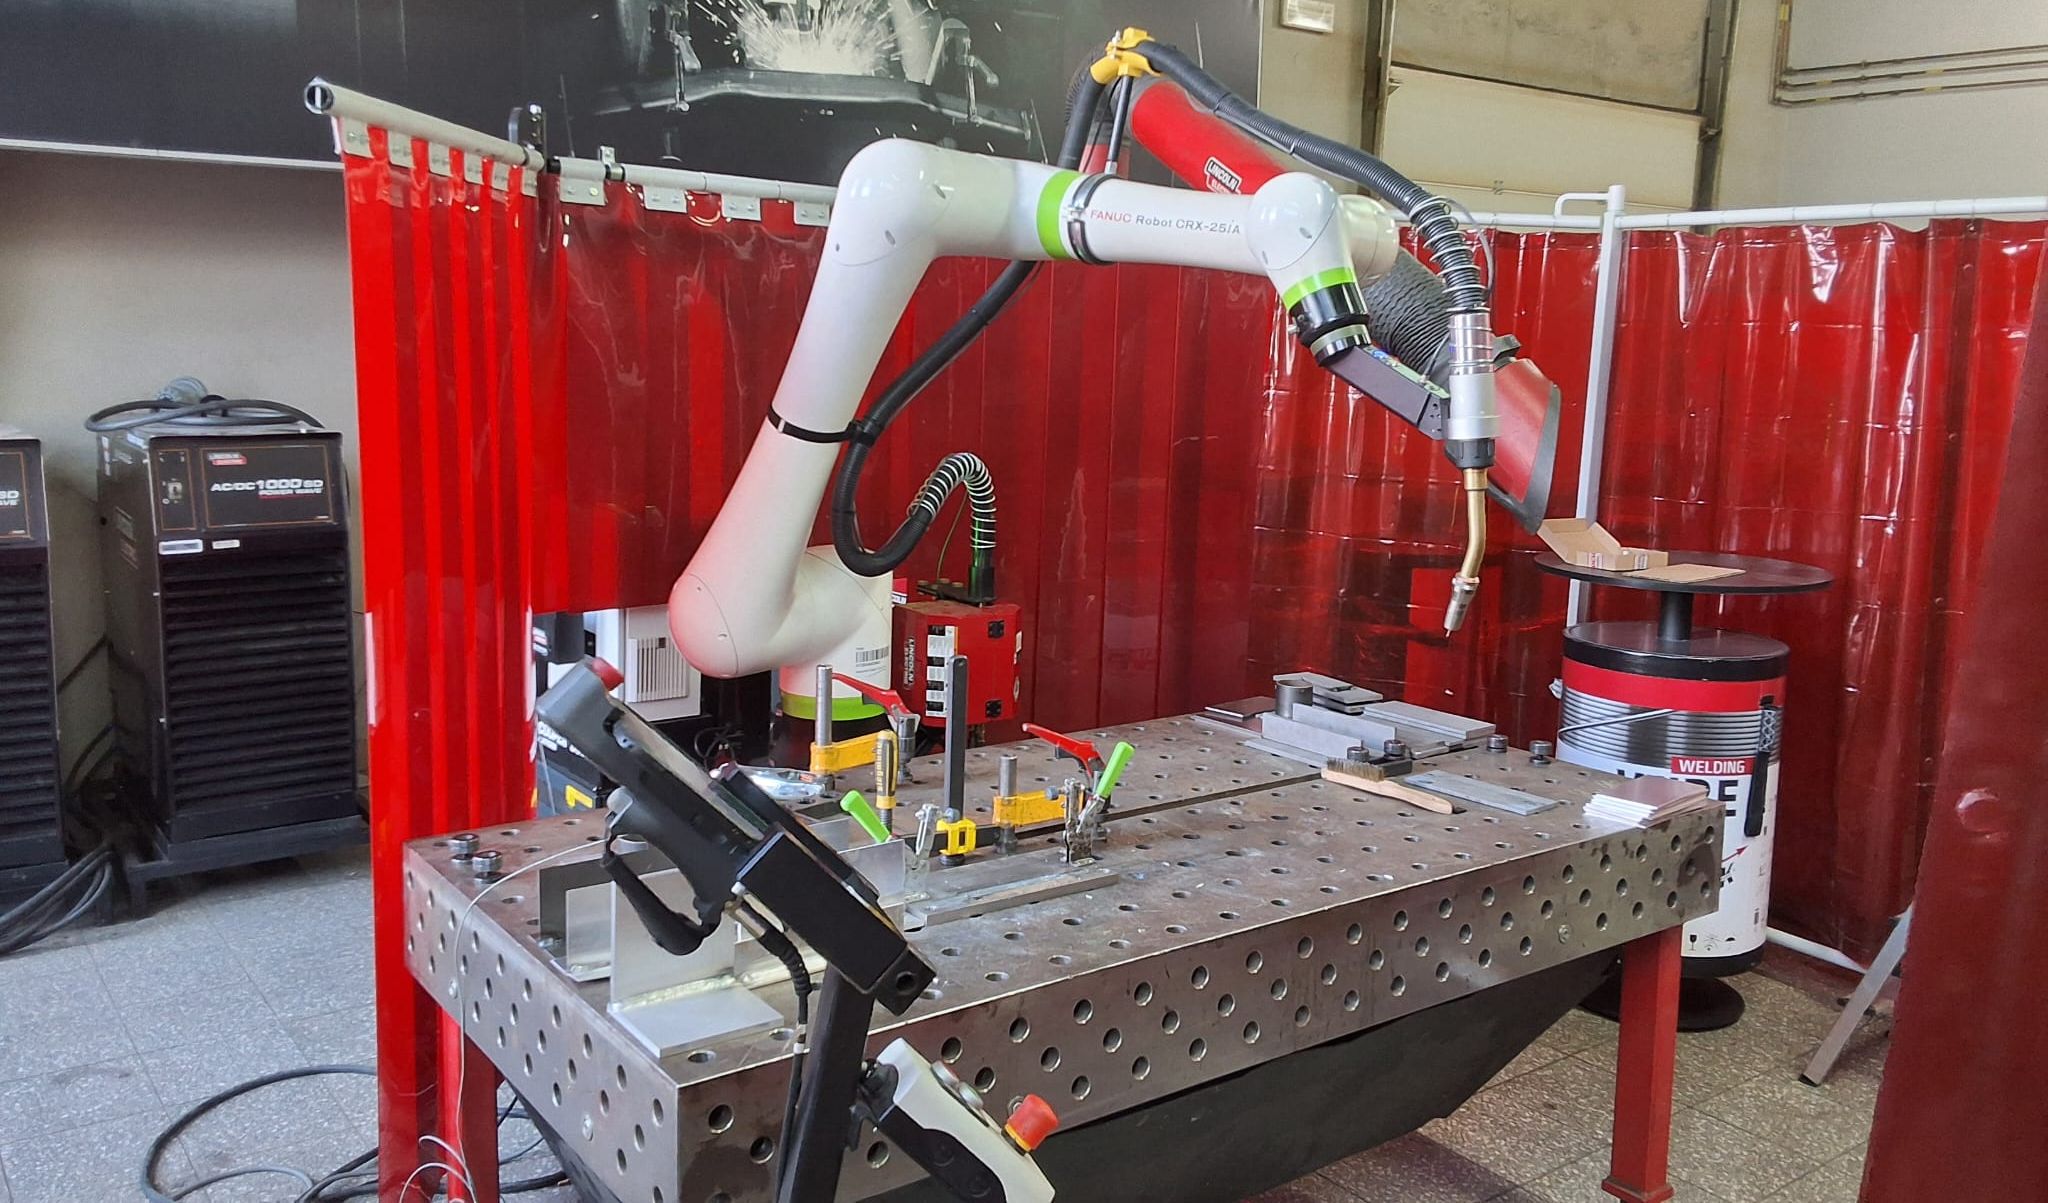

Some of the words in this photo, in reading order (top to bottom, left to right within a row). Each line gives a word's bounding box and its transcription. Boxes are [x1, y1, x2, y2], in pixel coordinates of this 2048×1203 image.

[1207, 161, 1238, 190] LINCOLN
[1090, 209, 1132, 223] FANUC
[1136, 214, 1172, 228] Robot
[1678, 759, 1745, 774] WELDING
